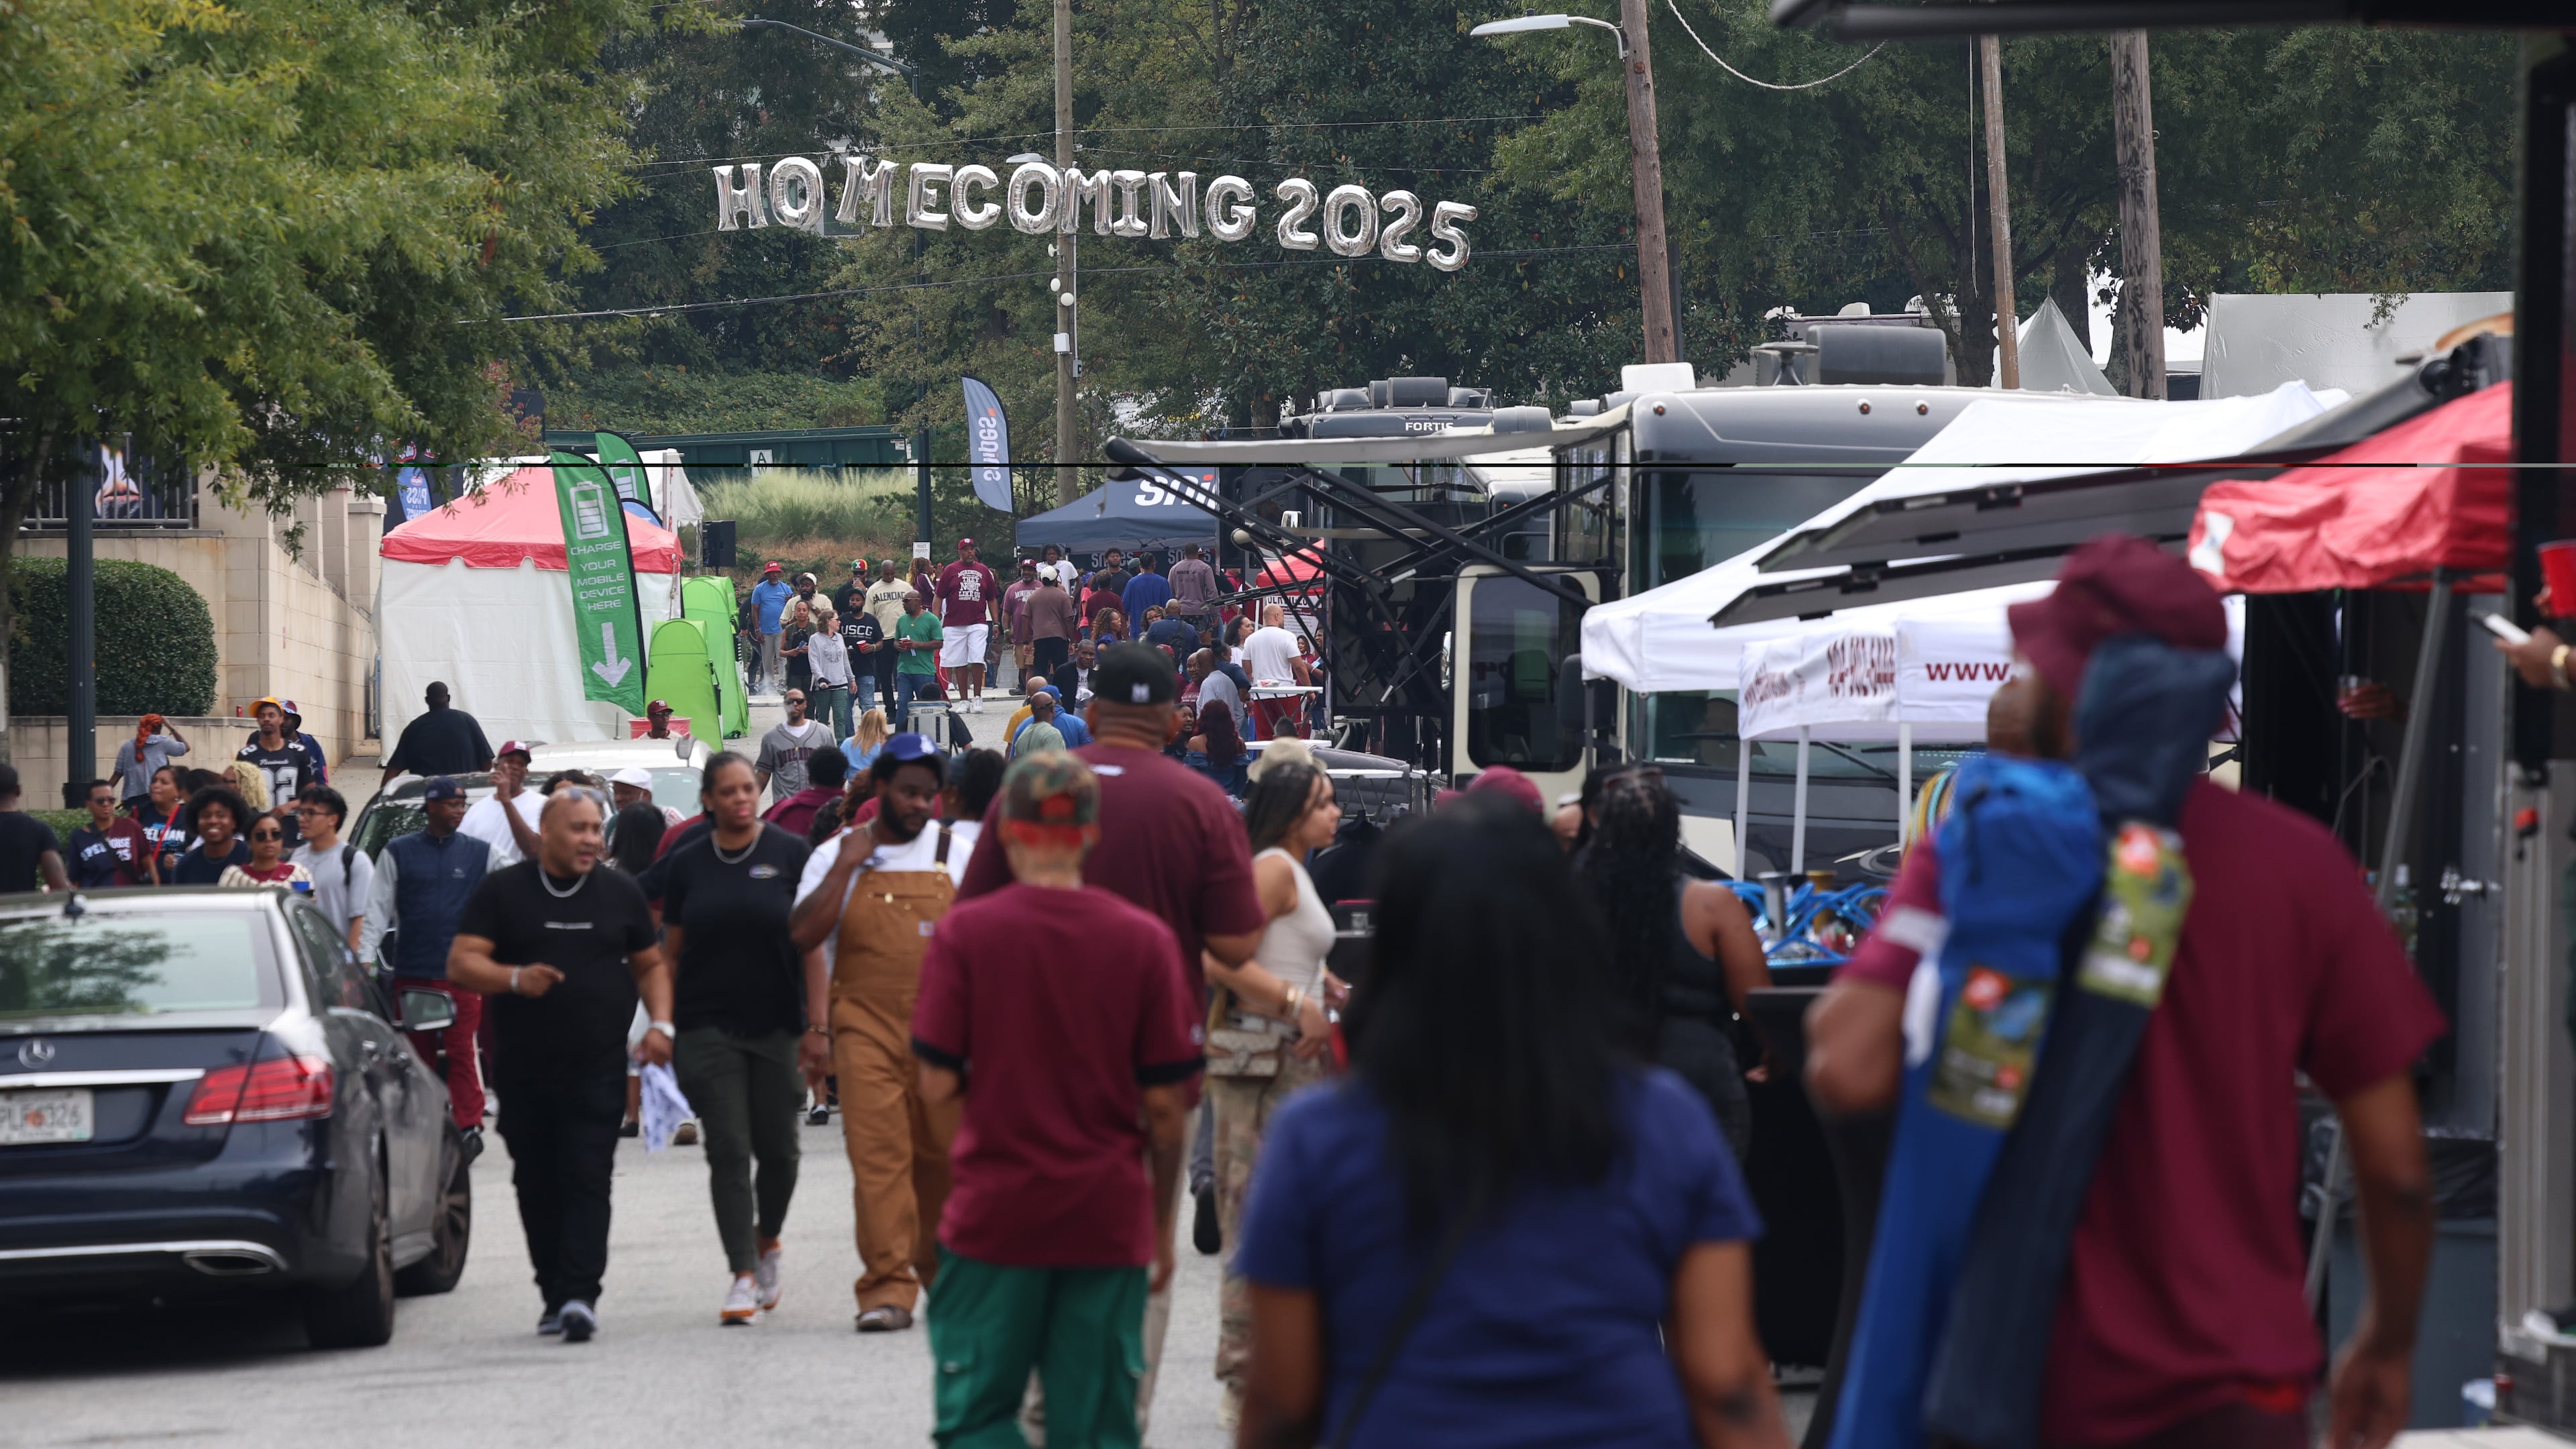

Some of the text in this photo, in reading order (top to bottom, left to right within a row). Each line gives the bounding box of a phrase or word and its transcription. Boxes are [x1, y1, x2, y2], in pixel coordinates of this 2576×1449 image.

[712, 156, 1478, 272] HOMECOMING 2025
[1405, 422, 1454, 431] FORTIS
[570, 541, 622, 555] CHARGE
[580, 559, 616, 572] YOUR
[577, 573, 625, 587] MOBILE
[580, 586, 626, 599] DEVICE
[588, 599, 623, 611] HERE
[841, 625, 873, 637] USCG
